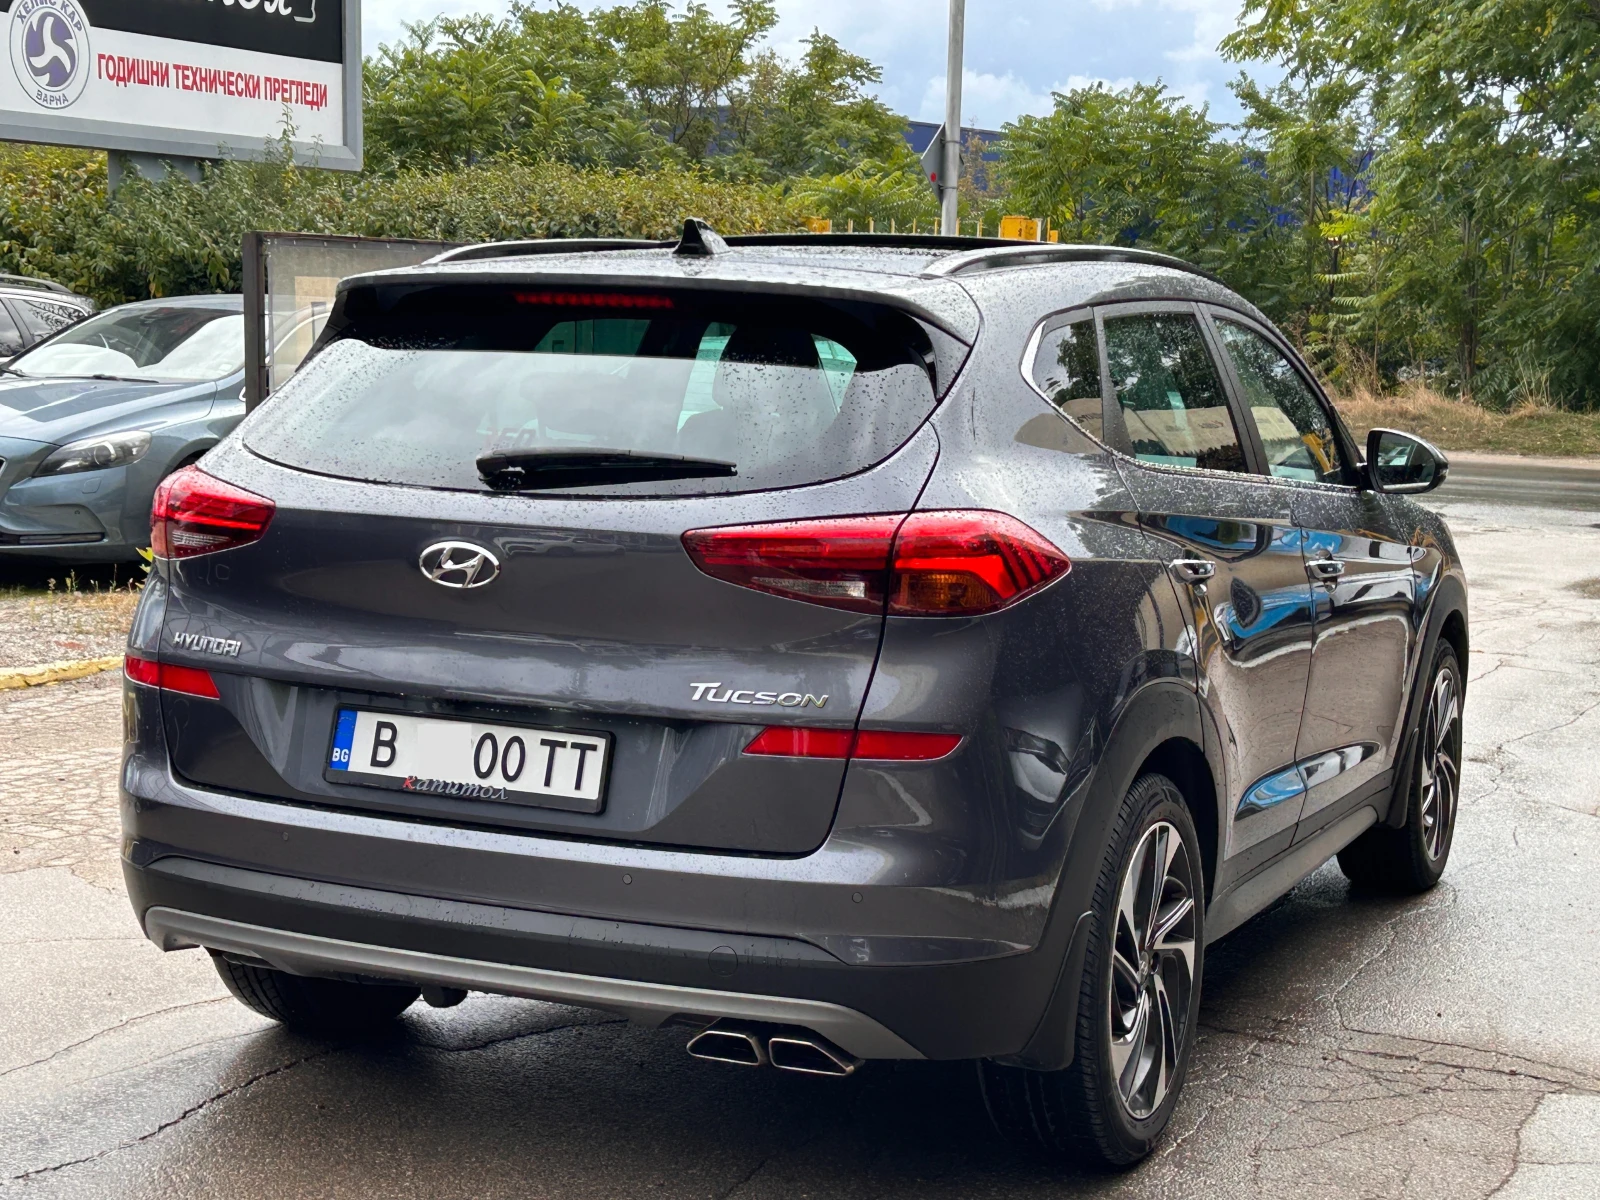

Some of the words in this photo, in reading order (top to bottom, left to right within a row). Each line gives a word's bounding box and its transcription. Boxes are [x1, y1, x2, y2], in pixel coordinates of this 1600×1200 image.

[60, 0, 83, 32] КАР
[97, 53, 170, 88] ГОДИШНИ
[173, 64, 260, 100] ТЕХНИЧЕСКИ
[264, 76, 328, 111] ПРЕГЛЕДИ
[35, 89, 69, 106] ВАРНА
[173, 632, 242, 657] HYUNDAI
[332, 747, 350, 763] BG
